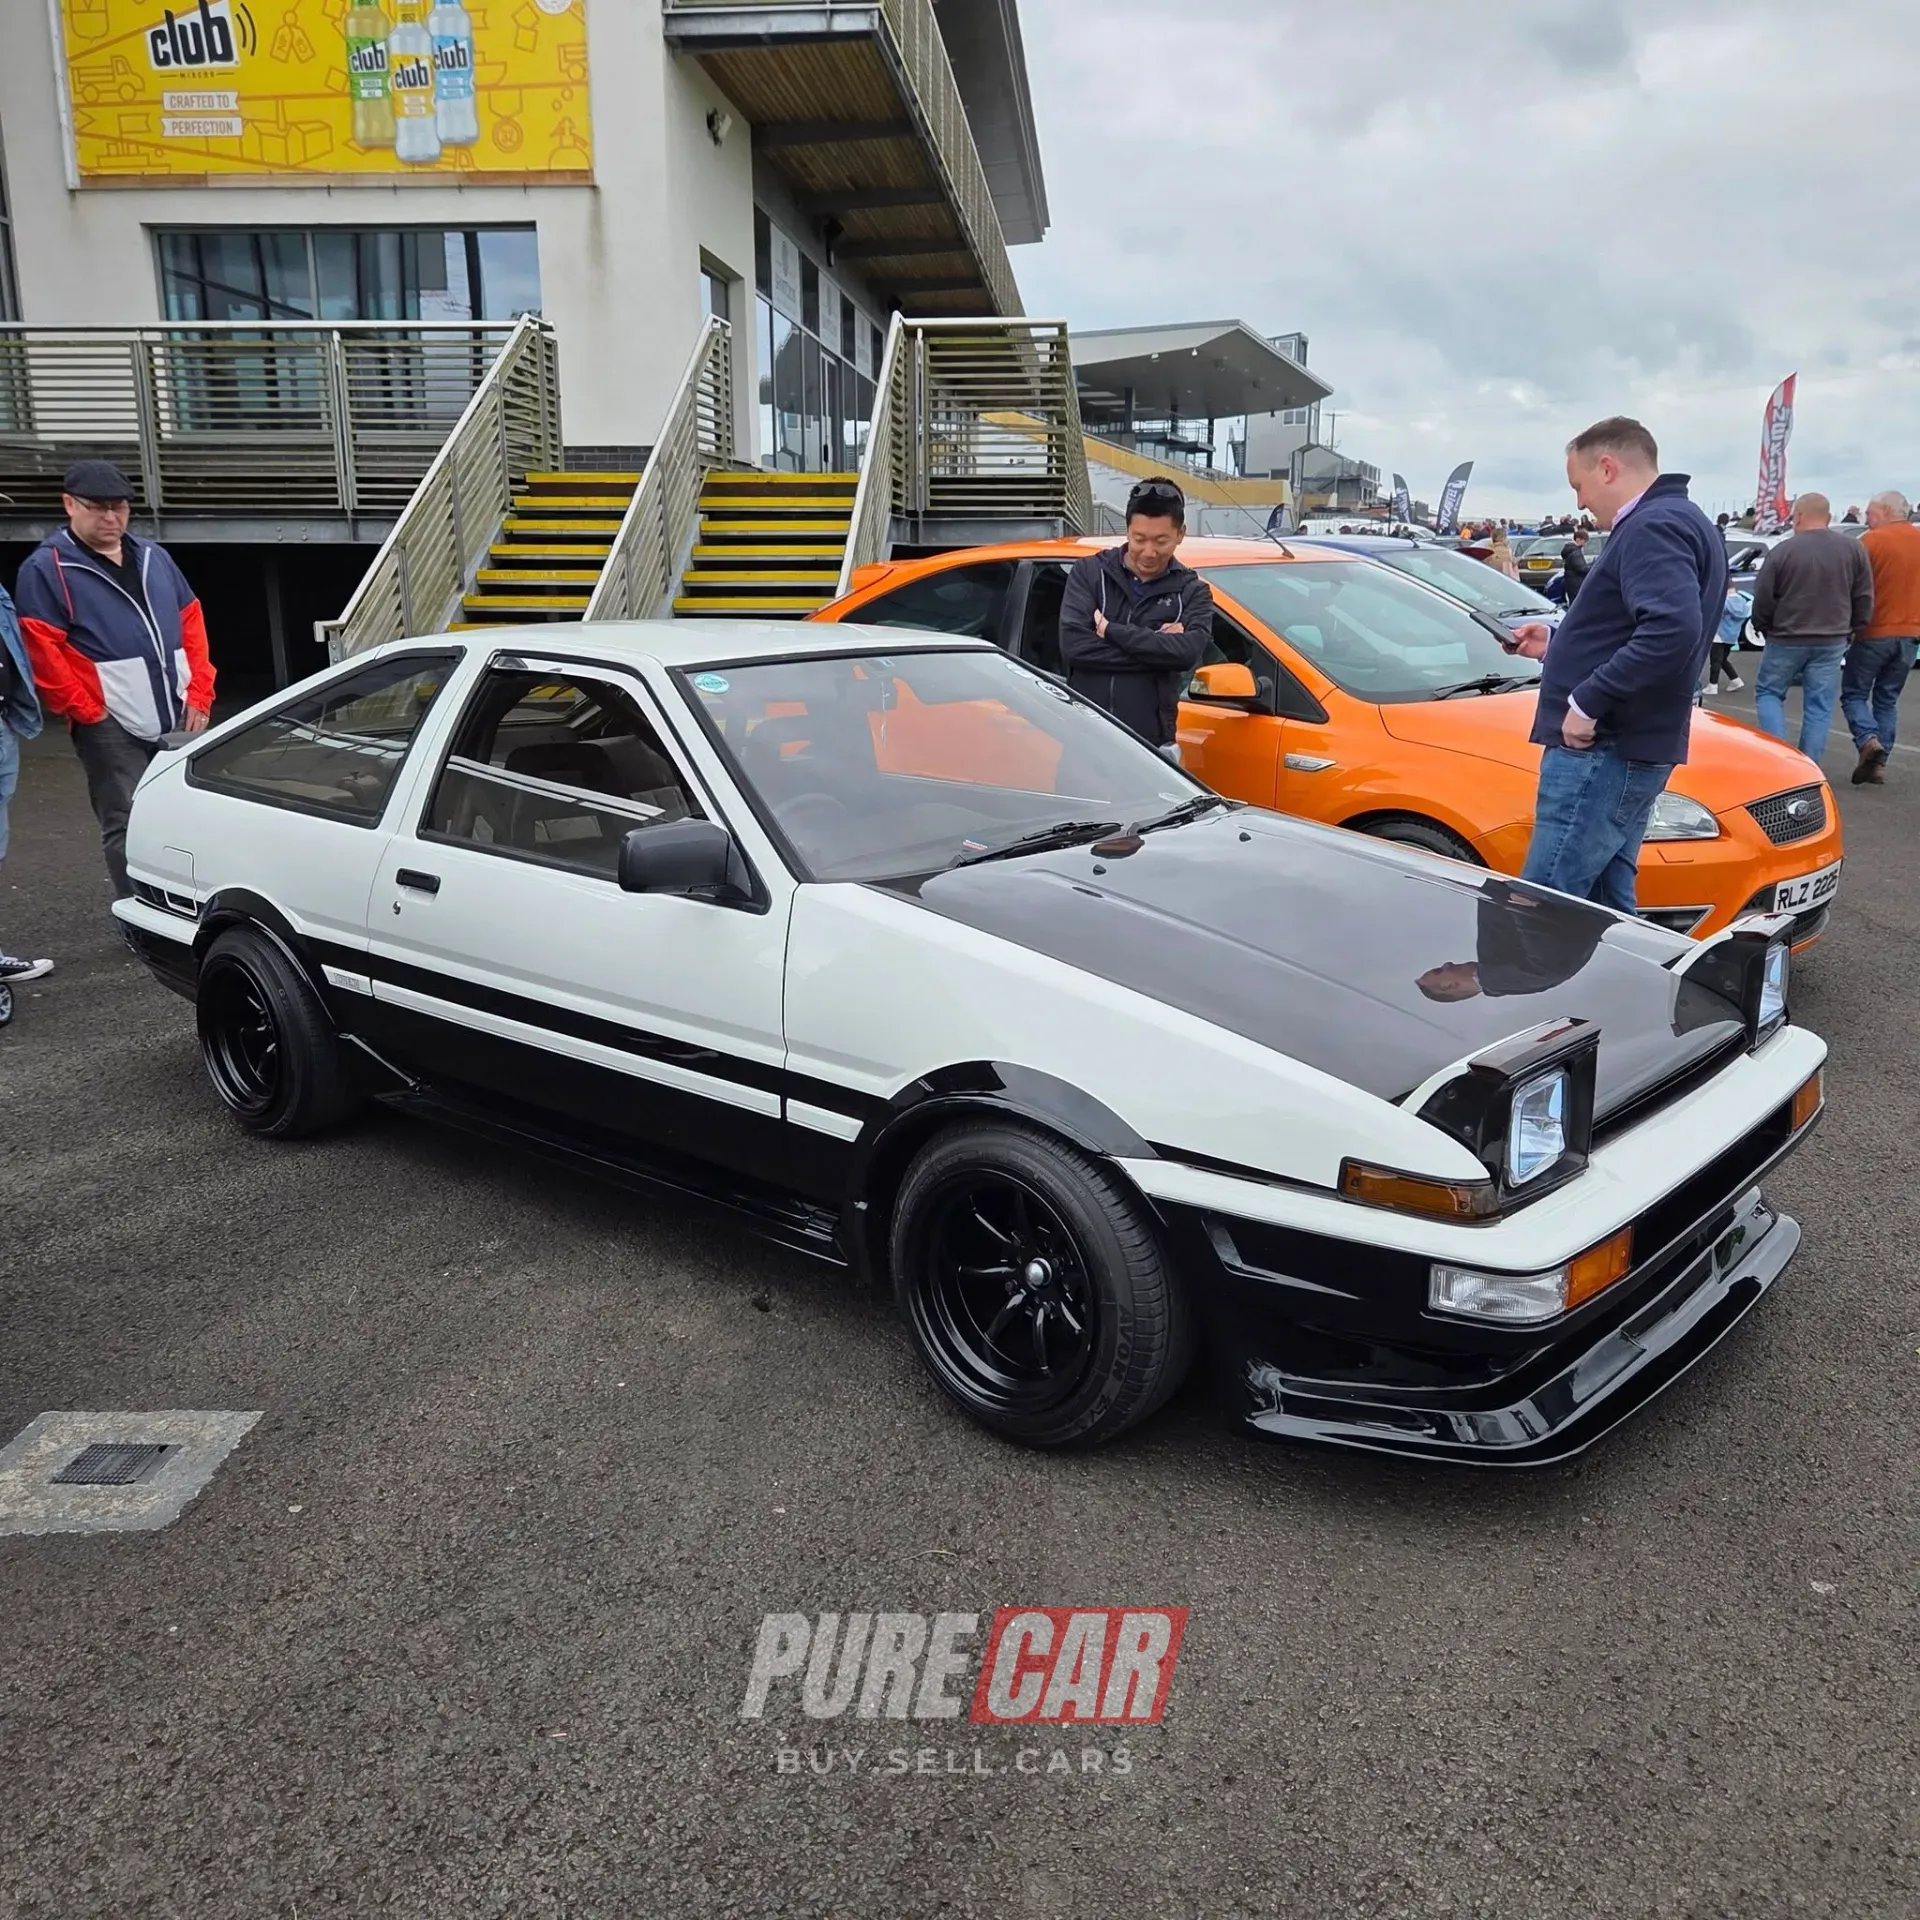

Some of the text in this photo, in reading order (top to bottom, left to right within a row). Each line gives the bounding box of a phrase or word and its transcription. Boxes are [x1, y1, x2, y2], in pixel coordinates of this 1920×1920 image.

[150, 0, 234, 67] club
[351, 40, 386, 72] club
[434, 39, 468, 70] club
[395, 57, 429, 89] club
[170, 94, 230, 109] CRAFTED TO
[171, 120, 233, 134] PERFECTION
[1777, 882, 1810, 911] RLZ
